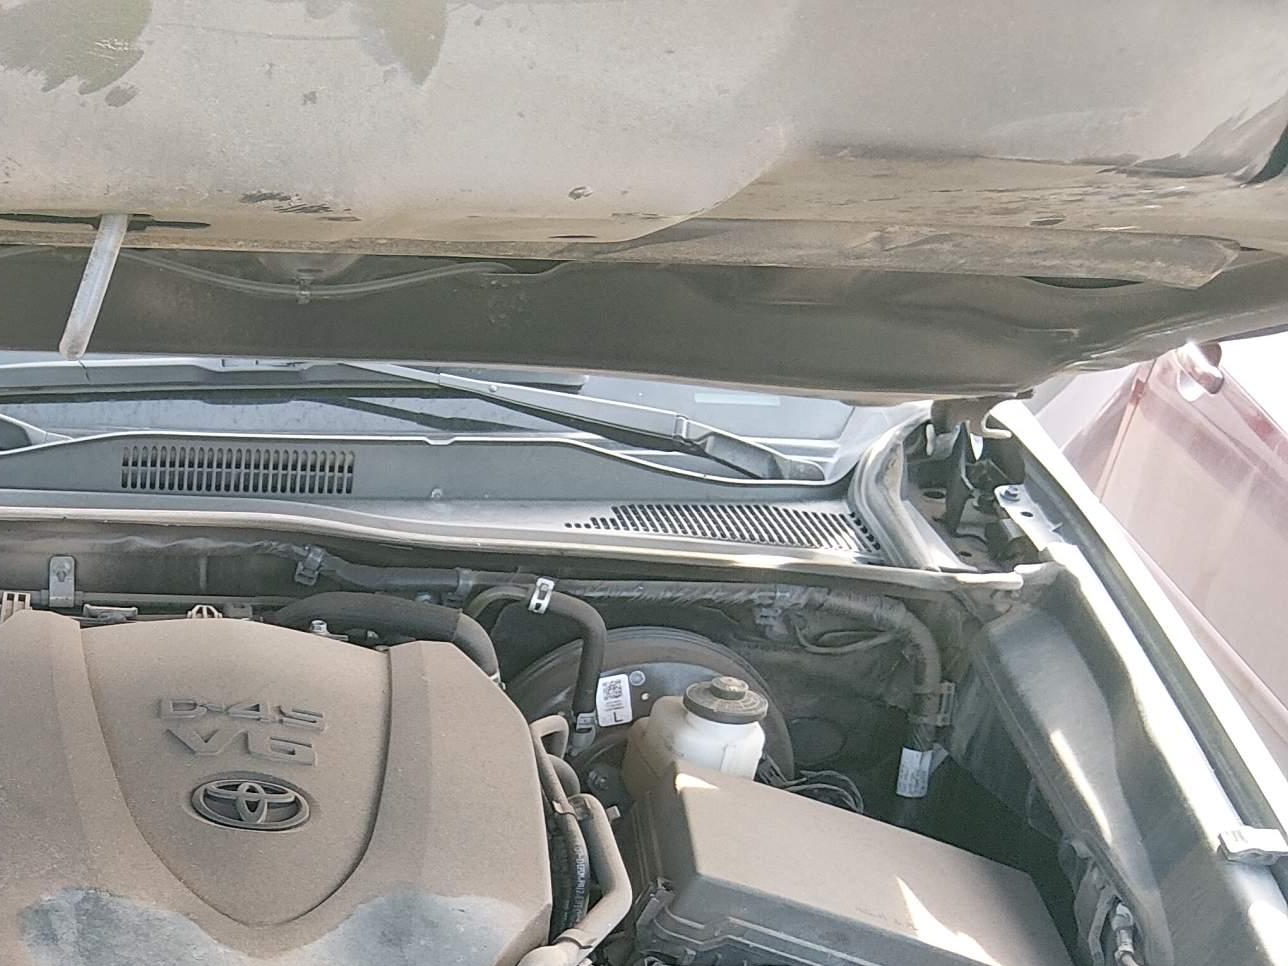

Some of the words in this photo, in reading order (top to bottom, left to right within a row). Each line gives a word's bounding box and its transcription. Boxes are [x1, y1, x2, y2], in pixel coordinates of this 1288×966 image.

[161, 698, 325, 731] D-4S
[613, 712, 623, 722] L
[166, 728, 317, 767] V6
